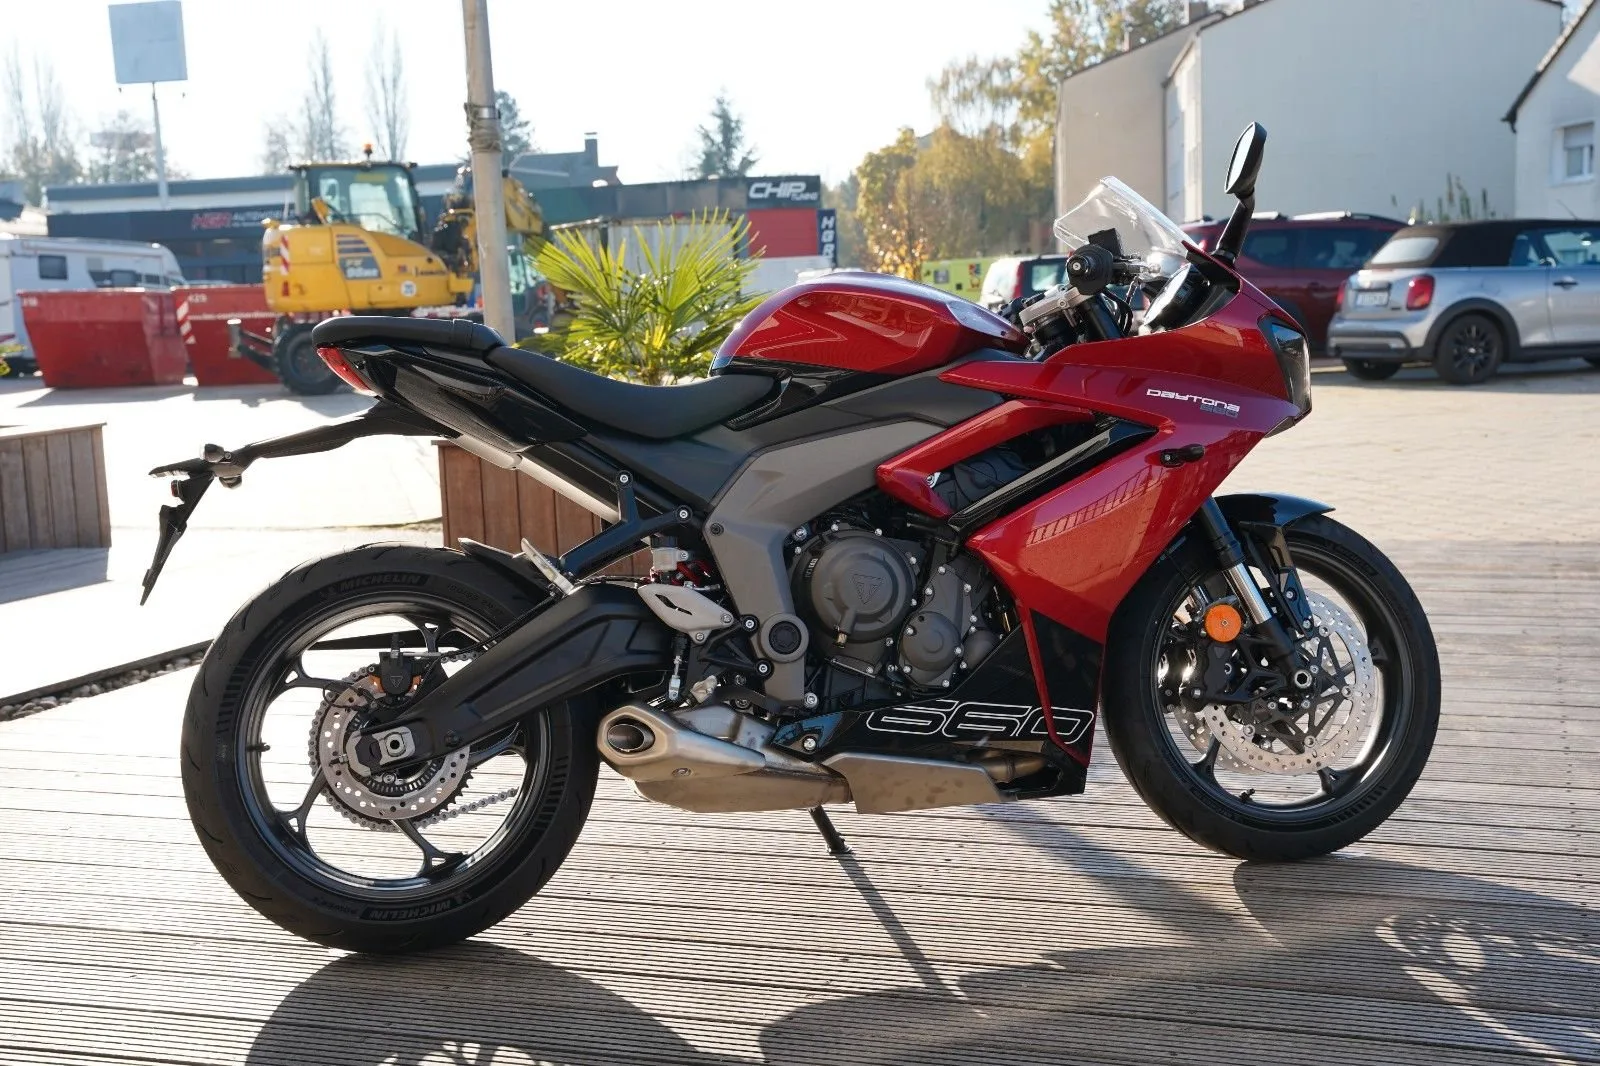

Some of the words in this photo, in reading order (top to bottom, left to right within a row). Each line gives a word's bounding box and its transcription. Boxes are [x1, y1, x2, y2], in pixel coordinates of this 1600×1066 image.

[748, 182, 807, 199] CHIP
[340, 573, 421, 593] MICHELIN
[866, 698, 1094, 745] 660
[369, 899, 451, 921] MICHELIN
